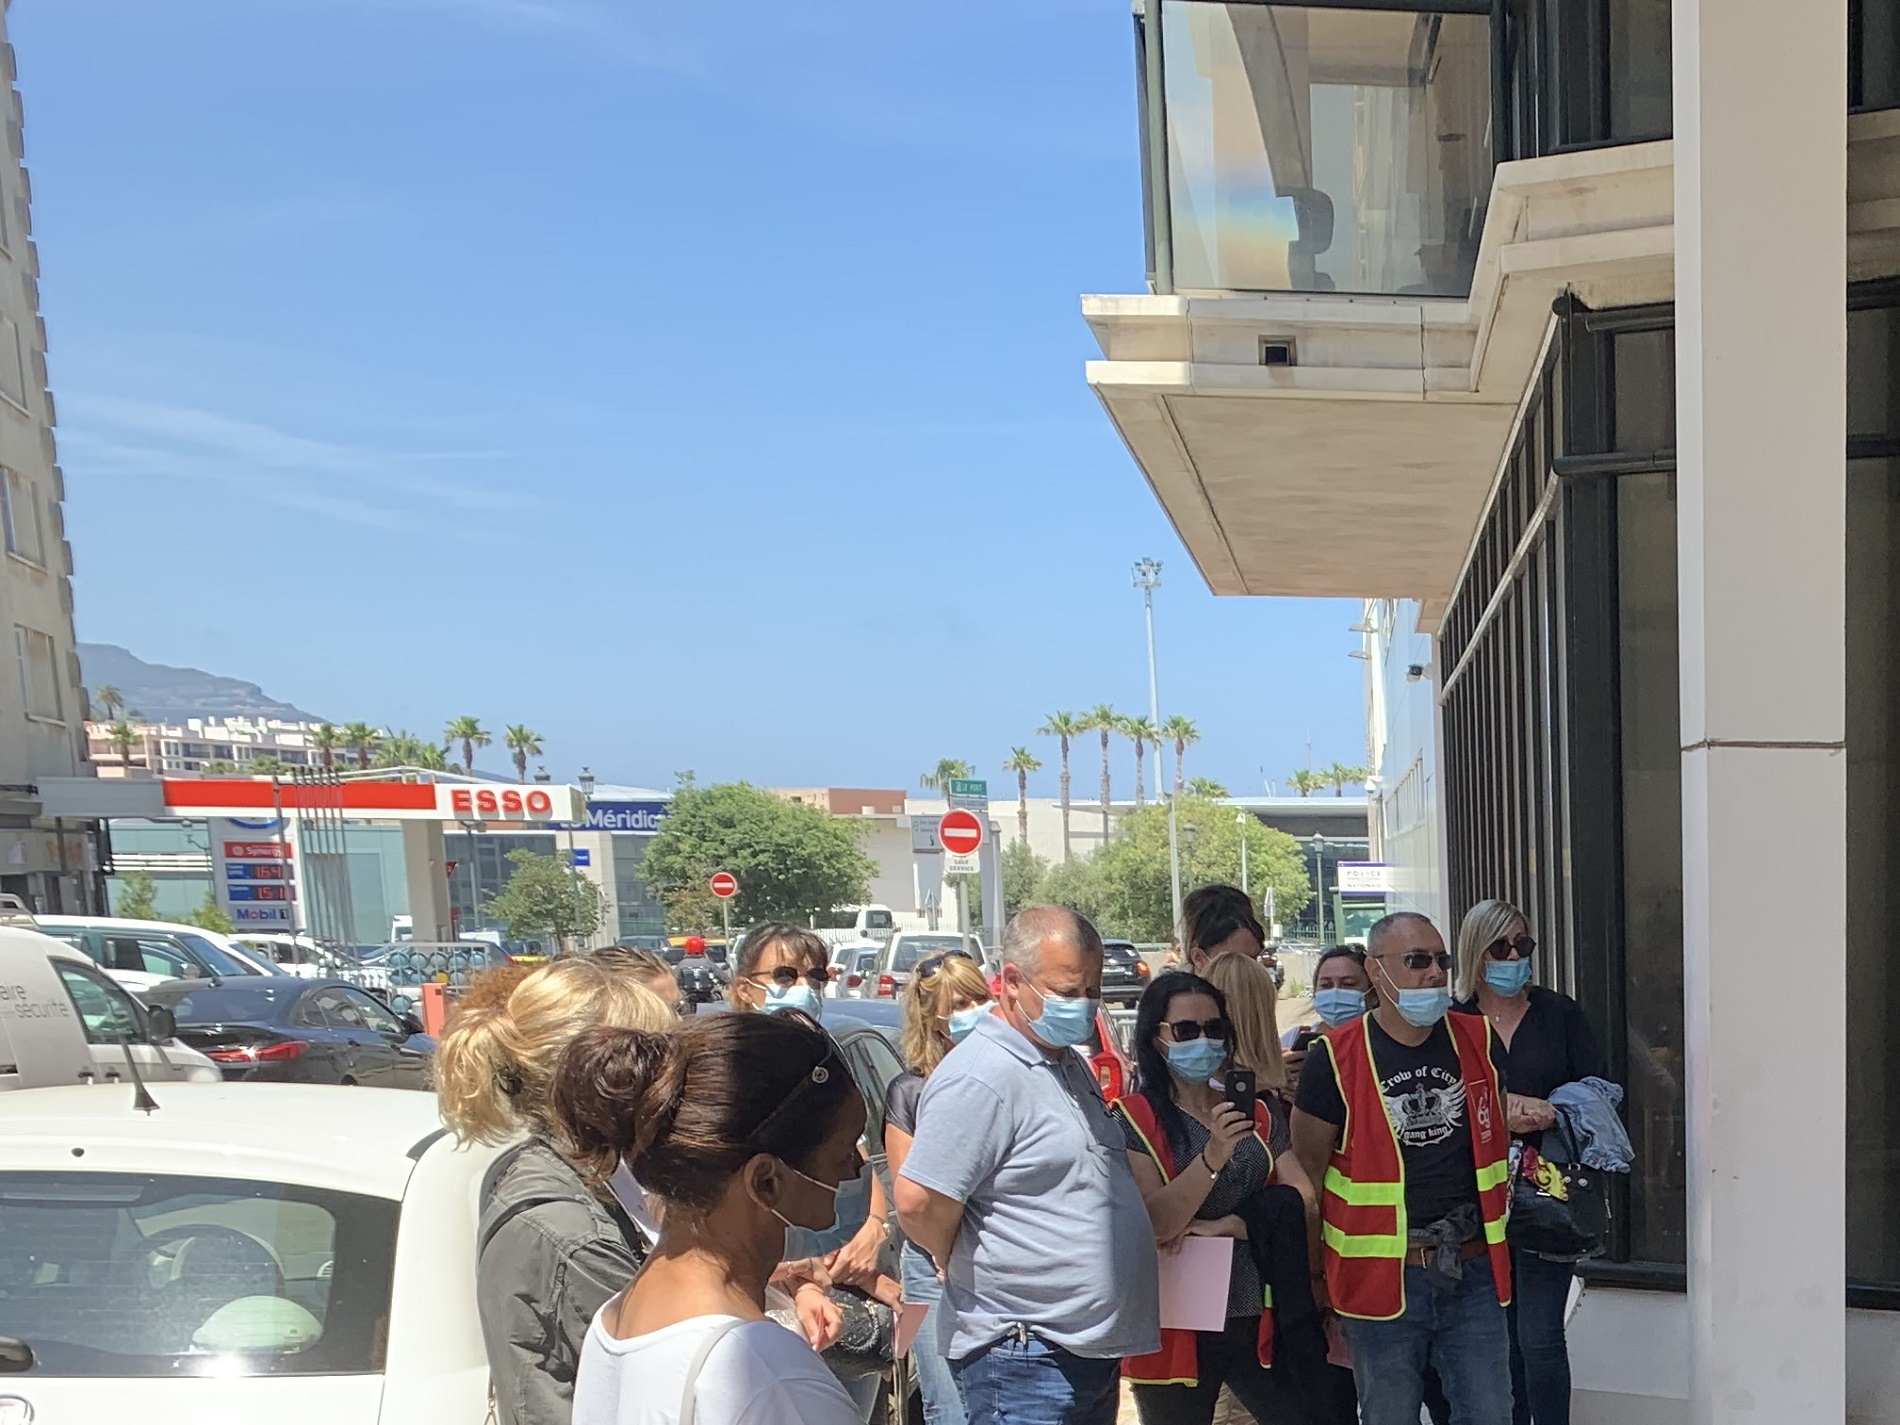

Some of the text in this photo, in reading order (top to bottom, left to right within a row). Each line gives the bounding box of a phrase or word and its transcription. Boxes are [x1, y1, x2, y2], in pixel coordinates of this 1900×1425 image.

[451, 790, 552, 813] ESSO
[237, 909, 276, 919] Mobil
[1415, 1065, 1428, 1078] of
[1430, 1067, 1457, 1085] City
[1428, 1125, 1448, 1137] king
